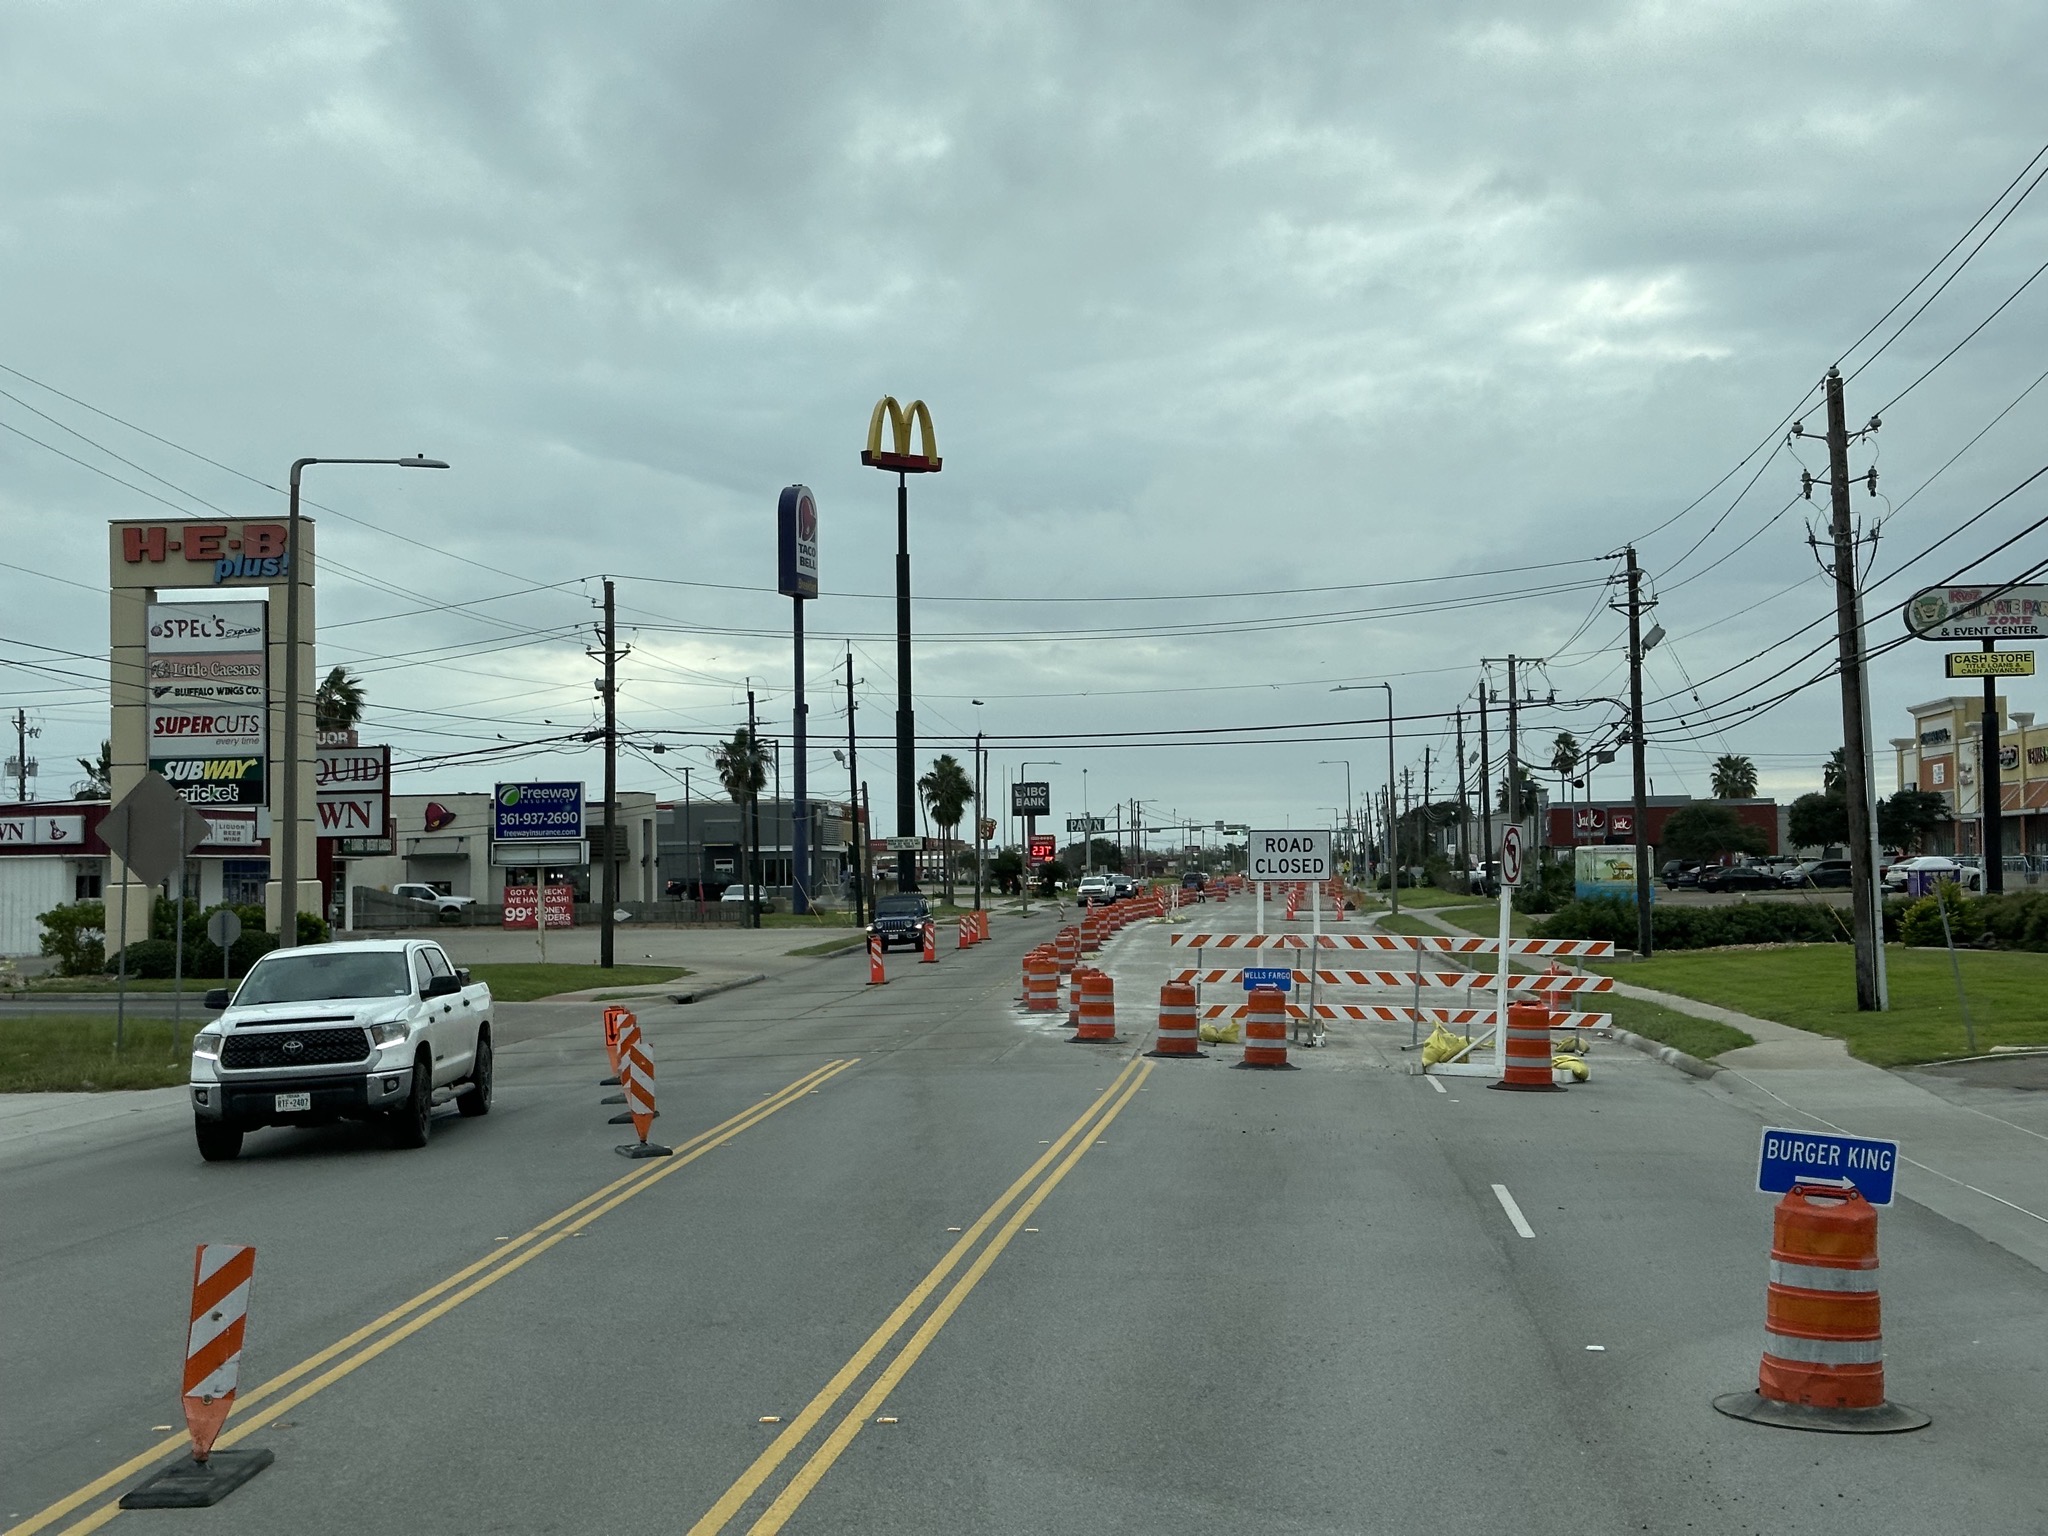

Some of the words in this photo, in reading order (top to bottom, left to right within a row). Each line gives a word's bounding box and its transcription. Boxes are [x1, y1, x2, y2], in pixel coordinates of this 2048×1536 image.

[123, 524, 288, 562] H-E-B
[798, 543, 816, 558] TACO
[213, 553, 289, 584] plus!
[800, 556, 816, 570] BELL
[1987, 616, 2033, 625] ZONE
[1941, 627, 1950, 636] &
[1954, 626, 1990, 636] EVENT
[1994, 625, 2038, 635] CENTER
[1954, 654, 1987, 664] CASH
[1991, 653, 2032, 662] STORE
[172, 662, 208, 677] Little
[211, 661, 260, 677] Caesars
[175, 687, 214, 697] BUFFALO
[216, 686, 244, 696] WINGS
[154, 715, 259, 734] SUPERCUTS
[241, 737, 260, 745] time
[161, 758, 258, 781] SUBWAY
[177, 784, 239, 802] cricket
[520, 786, 578, 801] Freeway
[1026, 786, 1047, 797] IBC
[1016, 797, 1046, 807] BANK
[500, 811, 578, 825] 361-937-2690
[503, 829, 577, 837] freewayinsurance.com
[1265, 837, 1314, 853] ROAD
[1255, 858, 1324, 874] CLOSED
[508, 896, 521, 904] WE
[522, 896, 538, 904] HAV
[1244, 971, 1267, 980] WELLS
[1268, 971, 1291, 980] FARGO
[1767, 1138, 1841, 1167] BURGER
[1847, 1147, 1892, 1172] KING
